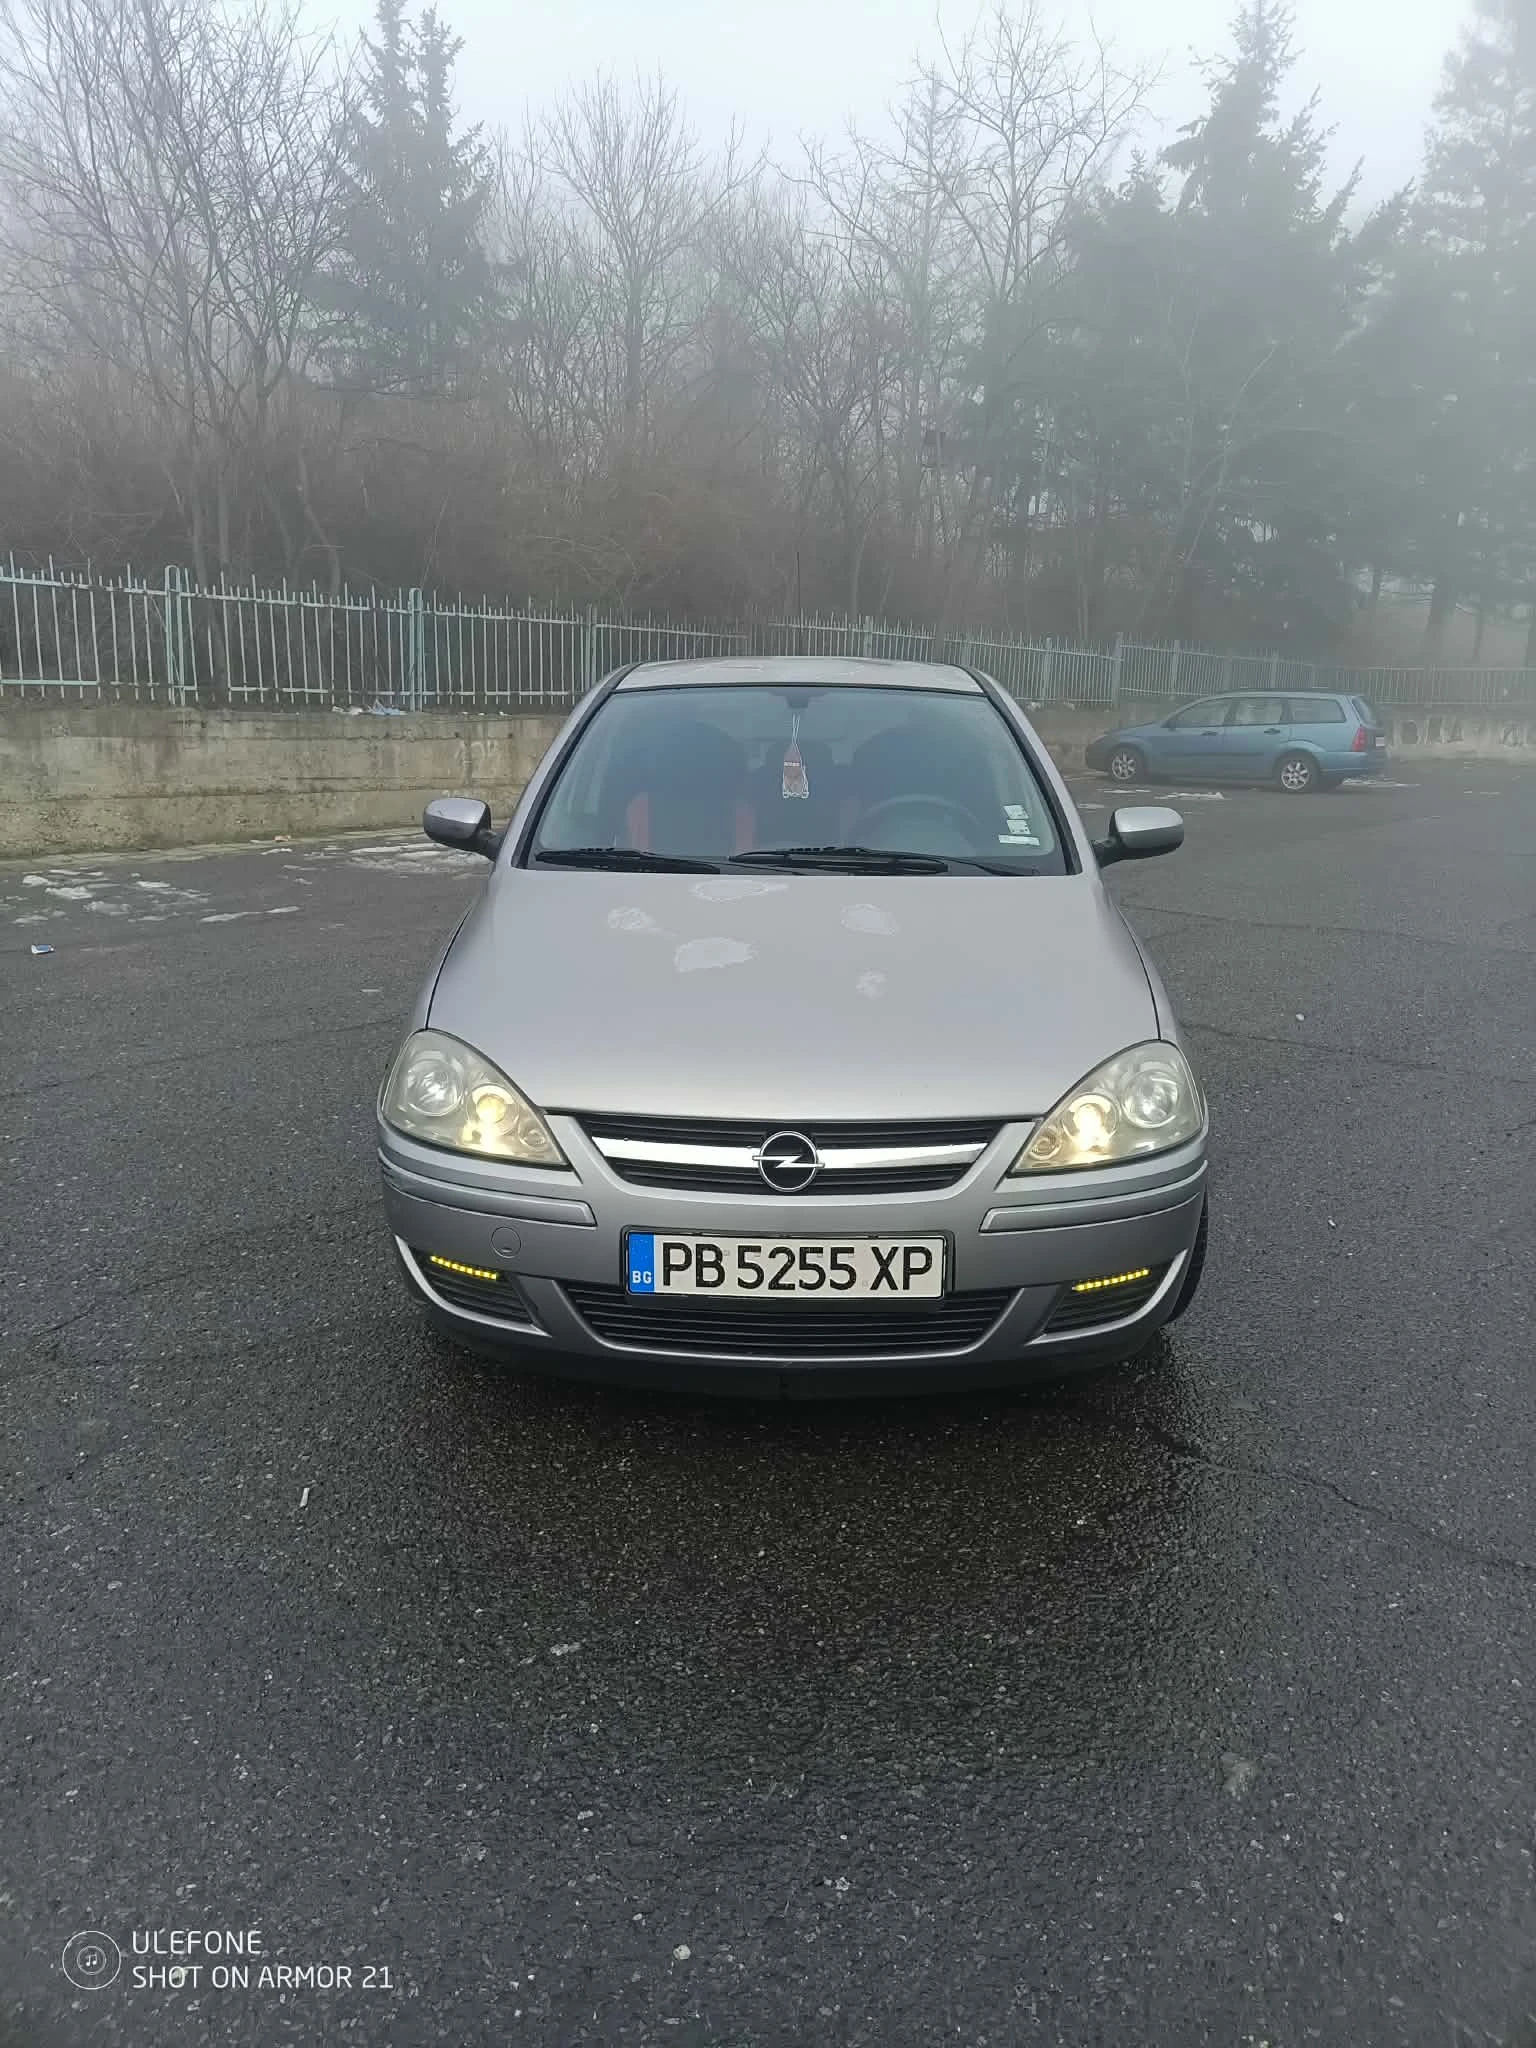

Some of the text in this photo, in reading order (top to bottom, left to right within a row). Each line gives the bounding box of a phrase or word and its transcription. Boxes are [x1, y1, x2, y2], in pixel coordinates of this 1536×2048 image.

[632, 1271, 652, 1283] BG
[662, 1242, 933, 1291] PB 5255 XP
